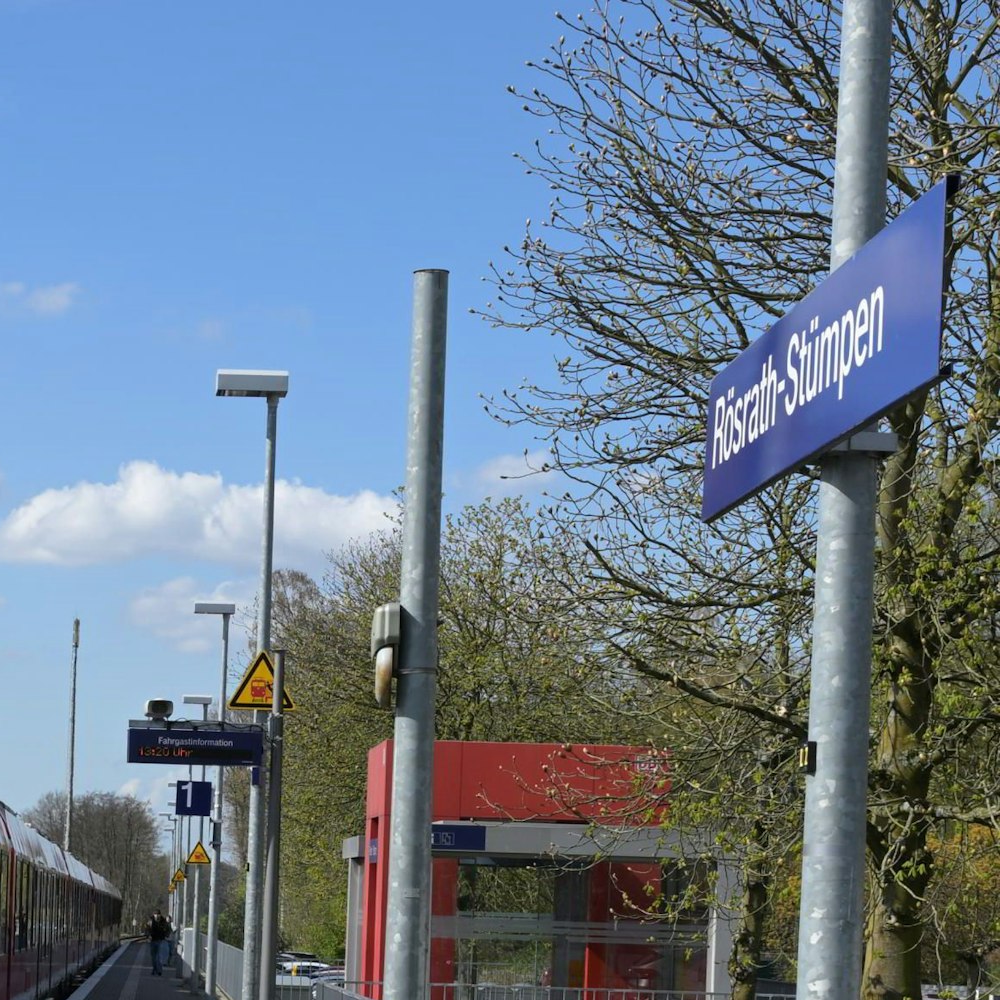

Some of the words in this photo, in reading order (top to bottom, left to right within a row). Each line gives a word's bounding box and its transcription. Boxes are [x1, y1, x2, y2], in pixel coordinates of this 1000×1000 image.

[711, 285, 885, 470] Rösrath-Stümpen
[158, 736, 233, 747] Fahrgastinformation
[172, 747, 194, 758] Uhr
[181, 781, 193, 808] 1
